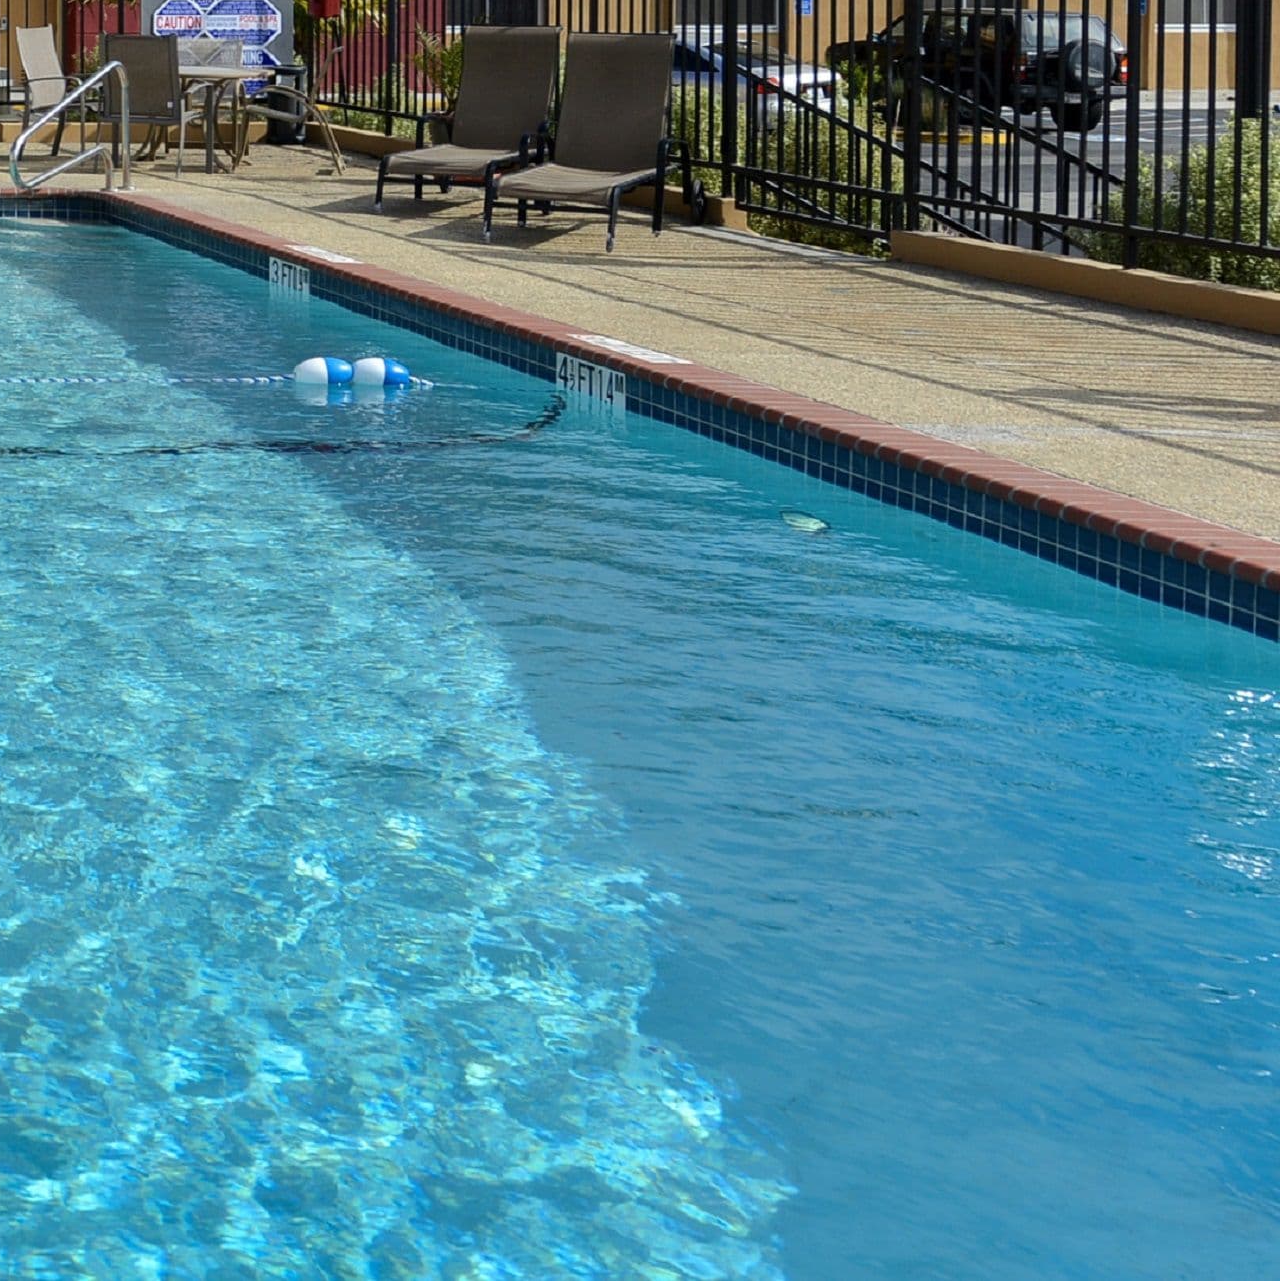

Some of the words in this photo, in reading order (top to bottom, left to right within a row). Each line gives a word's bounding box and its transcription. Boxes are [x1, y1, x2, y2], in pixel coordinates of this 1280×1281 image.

[156, 16, 202, 29] CAUTION
[272, 259, 279, 283] 3
[282, 263, 293, 287] FT
[578, 362, 595, 397] FT
